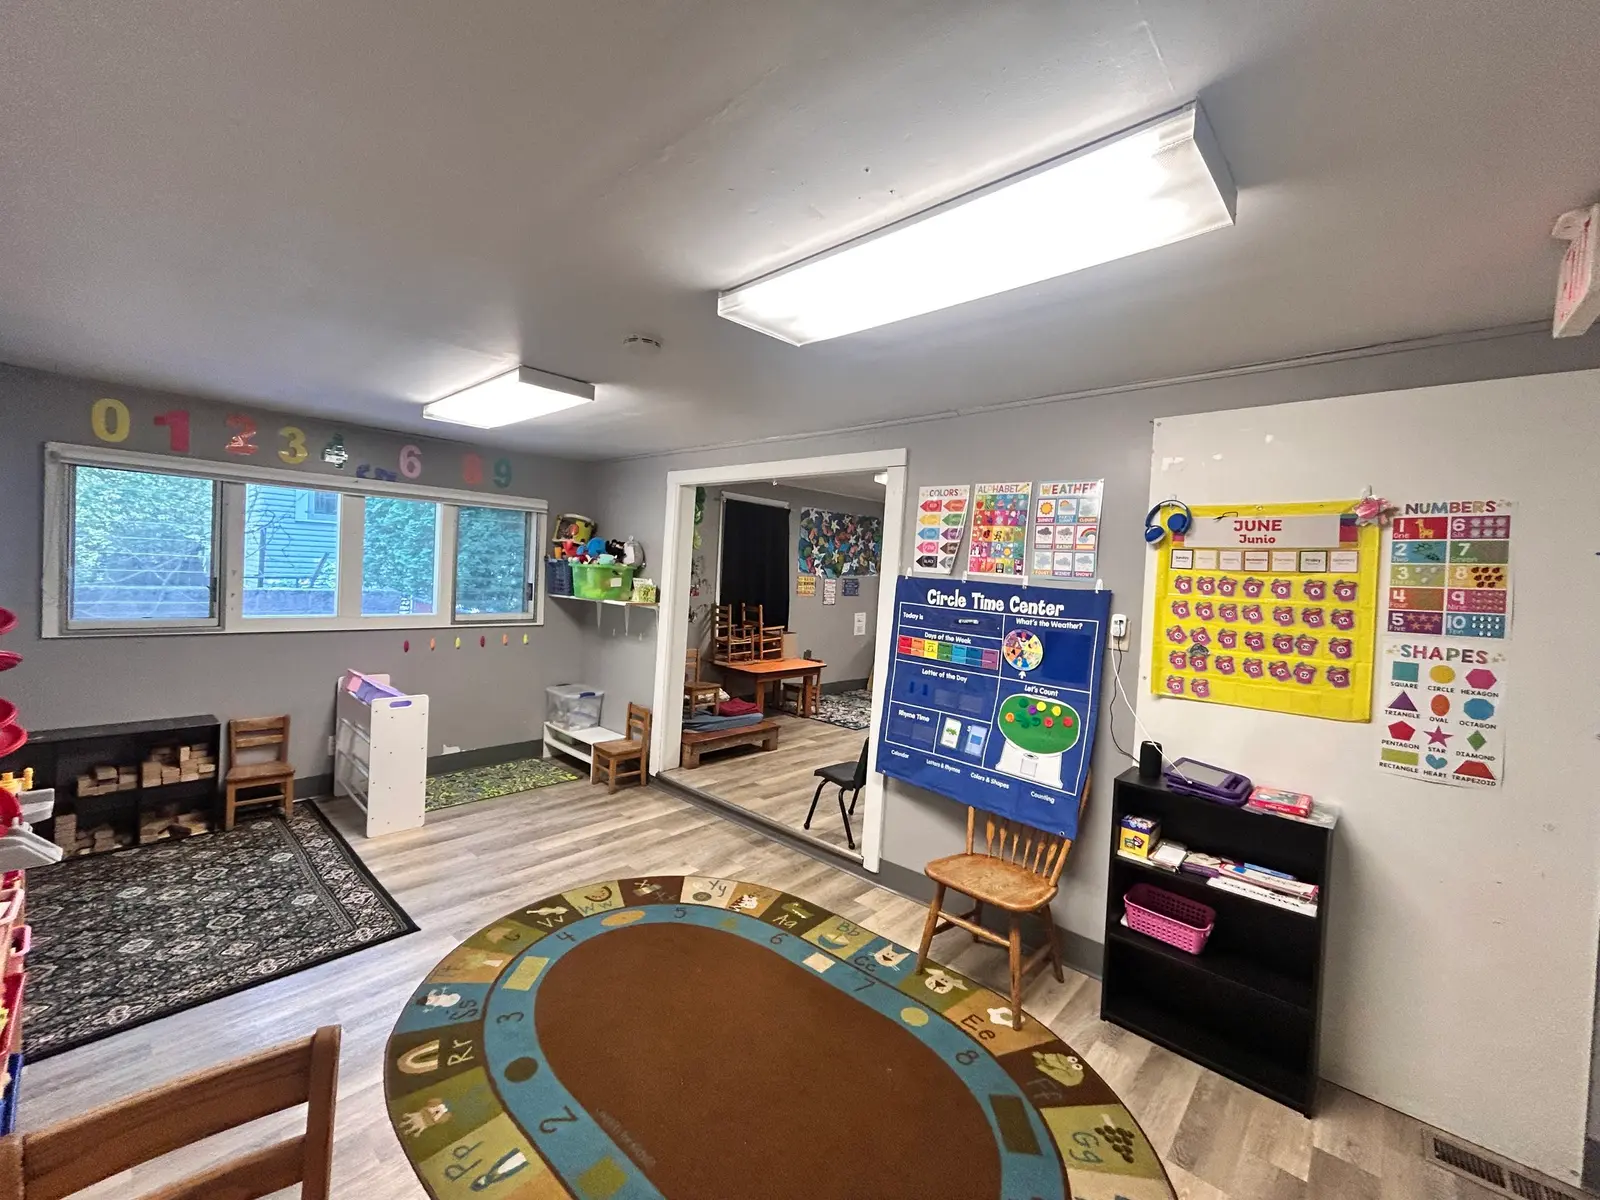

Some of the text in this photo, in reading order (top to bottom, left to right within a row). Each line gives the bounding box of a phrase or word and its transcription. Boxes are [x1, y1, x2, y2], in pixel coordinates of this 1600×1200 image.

[91, 398, 130, 443] 0
[153, 410, 191, 453] 1
[225, 413, 259, 456] 2
[278, 426, 309, 464] 3
[399, 444, 422, 479] 6
[492, 457, 513, 489] 9
[929, 489, 959, 497] COLORS
[978, 485, 1019, 494] ALPHABET
[1405, 501, 1496, 515] NUMBERS
[1234, 519, 1282, 532] JUNE
[1399, 519, 1405, 532] 1
[1452, 518, 1465, 532] 6
[1239, 534, 1276, 544] Junio
[1395, 543, 1407, 556] 2
[1458, 543, 1471, 556] 7
[1397, 567, 1409, 580] 3
[1455, 566, 1468, 580] 8
[927, 588, 1064, 616] Circle Time Center
[1392, 589, 1406, 602] 4
[1451, 591, 1465, 605] 9
[903, 611, 918, 621] Today
[1392, 613, 1404, 626] 5
[1447, 615, 1466, 629] 10
[1016, 617, 1038, 626] What's
[1050, 621, 1083, 630] Weather?
[924, 632, 937, 640] Days
[945, 634, 955, 642] the
[955, 636, 972, 645] Week
[1400, 644, 1489, 664] SHAPES
[922, 668, 938, 677] Letter
[956, 674, 968, 683] Day
[1024, 685, 1059, 697] Let's Count
[1390, 681, 1418, 689] SQUARE
[1427, 685, 1455, 693] CIRCLE
[1461, 689, 1499, 698] HEXAGON
[899, 709, 930, 722] Rhyme Time
[1384, 710, 1421, 719] TRIANGLE
[1429, 716, 1448, 724] OVAL
[1459, 720, 1497, 730] OCTAGON
[1381, 739, 1420, 750] PENTAGON
[1428, 746, 1446, 754] STAR
[891, 749, 910, 759] Calendar
[1456, 751, 1496, 761] DIAMOND
[926, 759, 940, 769] Letters
[945, 764, 961, 774] Rhymes
[1379, 762, 1418, 774] RECTANGLE
[970, 772, 1010, 789] Colors & Shapes
[1423, 770, 1447, 779] HEART
[1452, 775, 1496, 787] TRAPEZOID
[1031, 790, 1055, 804] Counting
[708, 880, 727, 898] Yy
[654, 891, 677, 903] Xx
[577, 901, 613, 915] Ww
[674, 906, 687, 918] 5
[536, 915, 564, 928] Vv
[772, 914, 798, 929] Aa
[836, 921, 860, 938] Bb
[556, 931, 576, 942] 4
[770, 932, 789, 945] 6
[852, 954, 878, 973] Cc
[852, 978, 876, 992] 7
[449, 999, 478, 1021] Ss
[496, 1011, 524, 1024] 3
[960, 1014, 996, 1041] Ee
[446, 1038, 475, 1067] Rr
[955, 1050, 979, 1065] 8
[539, 1105, 580, 1133] 2
[1069, 1131, 1103, 1164] Gg
[444, 1140, 485, 1182] Pp
